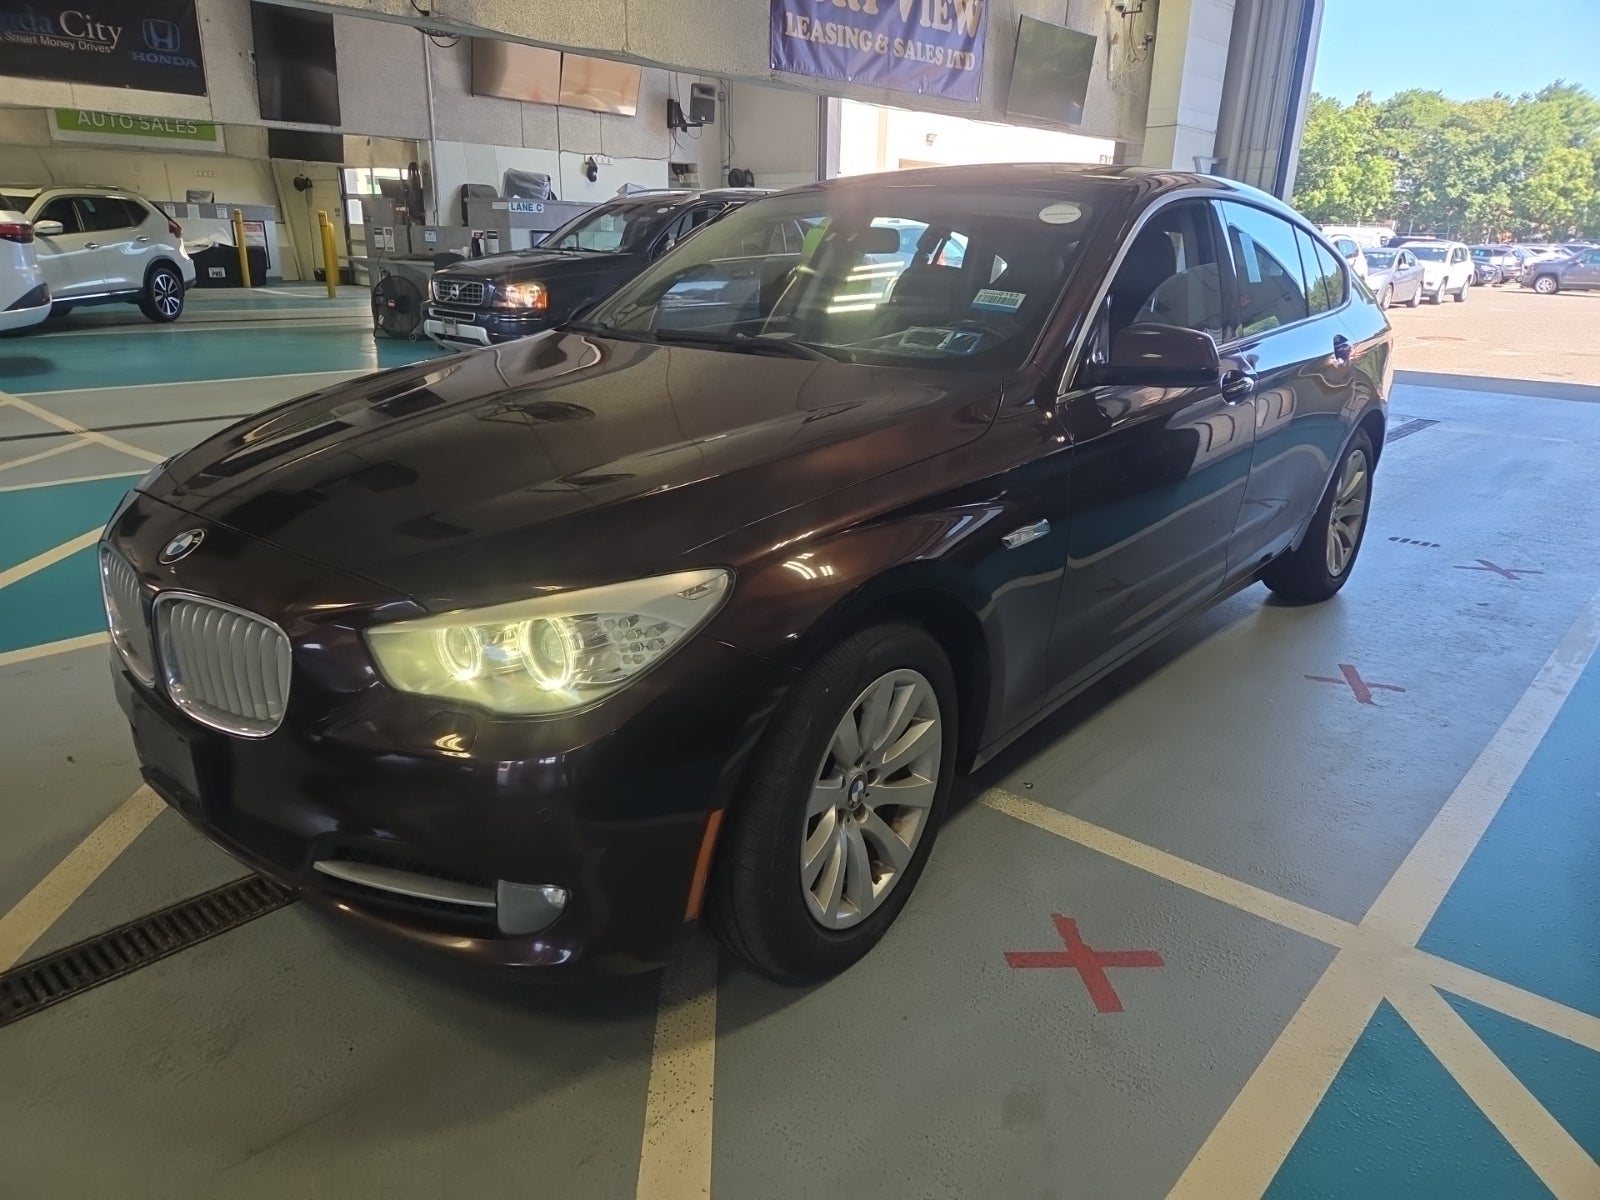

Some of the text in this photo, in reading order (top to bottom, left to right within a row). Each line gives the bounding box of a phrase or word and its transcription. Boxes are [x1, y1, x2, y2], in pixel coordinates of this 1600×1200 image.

[59, 10, 122, 49] City
[785, 12, 976, 71] LEASING & SALES LTD
[5, 31, 112, 54] Smart Money Drives
[131, 52, 198, 68] HONDA
[78, 110, 198, 135] AUTO SALES
[510, 203, 543, 212] LANE C
